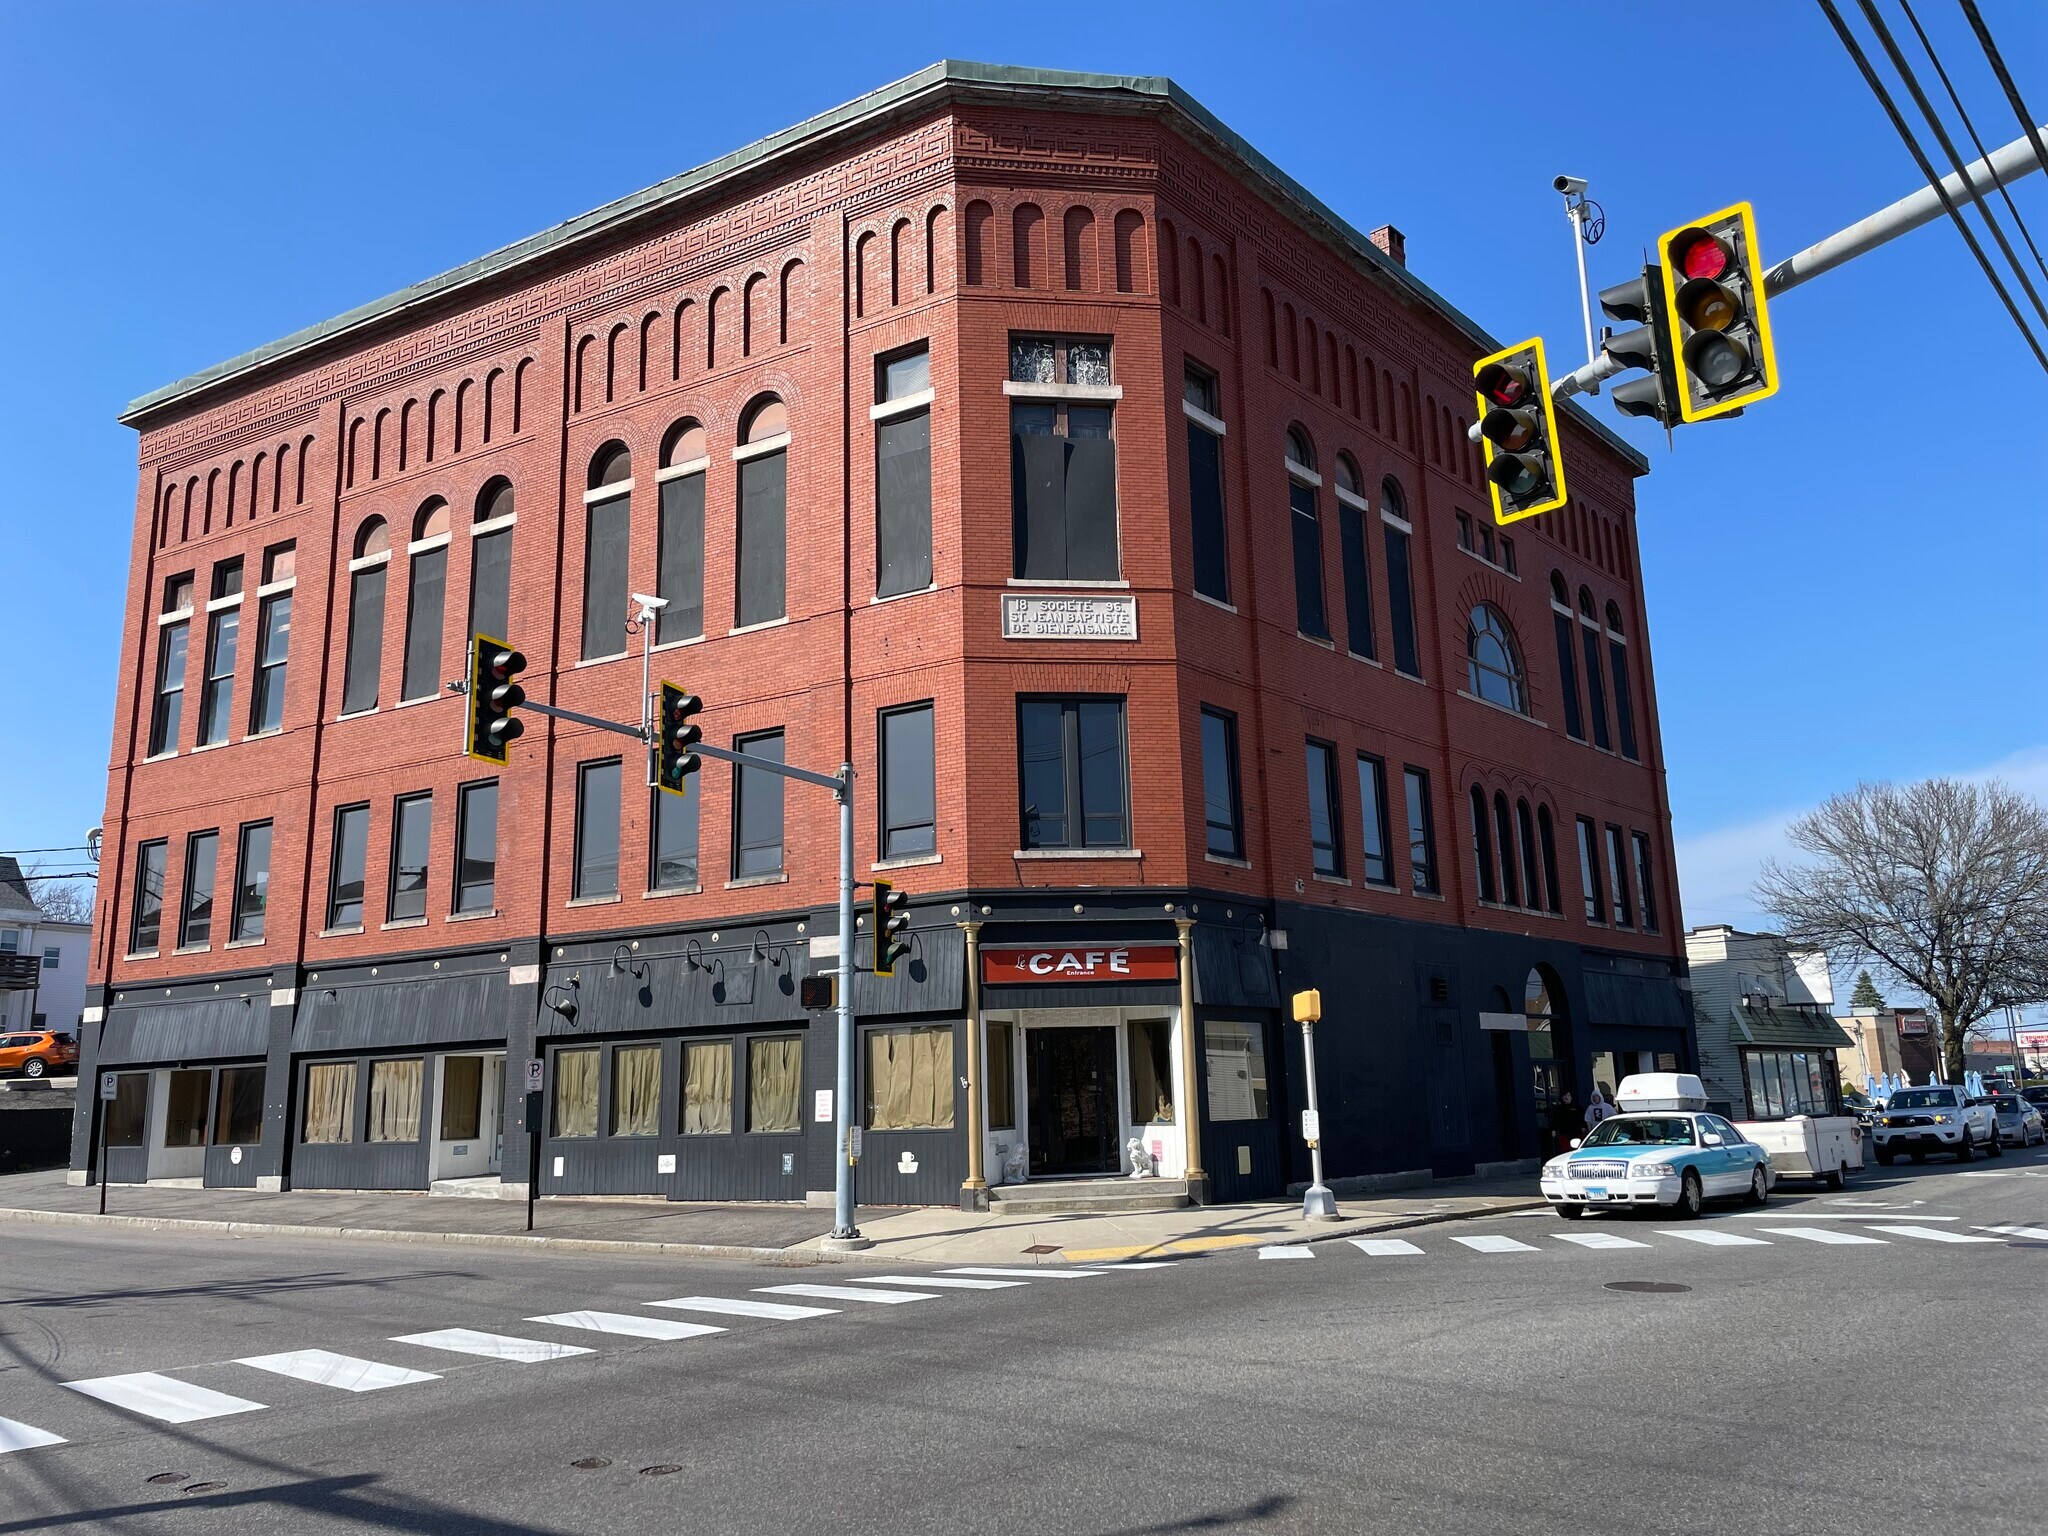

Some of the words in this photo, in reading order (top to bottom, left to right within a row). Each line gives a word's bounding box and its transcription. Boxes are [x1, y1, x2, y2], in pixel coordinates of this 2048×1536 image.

[1015, 599, 1028, 611] 18
[1067, 613, 1130, 624] BAPTISTE
[1011, 623, 1030, 634] DE
[1014, 954, 1026, 971] Le
[1029, 947, 1130, 975] CAFÉ
